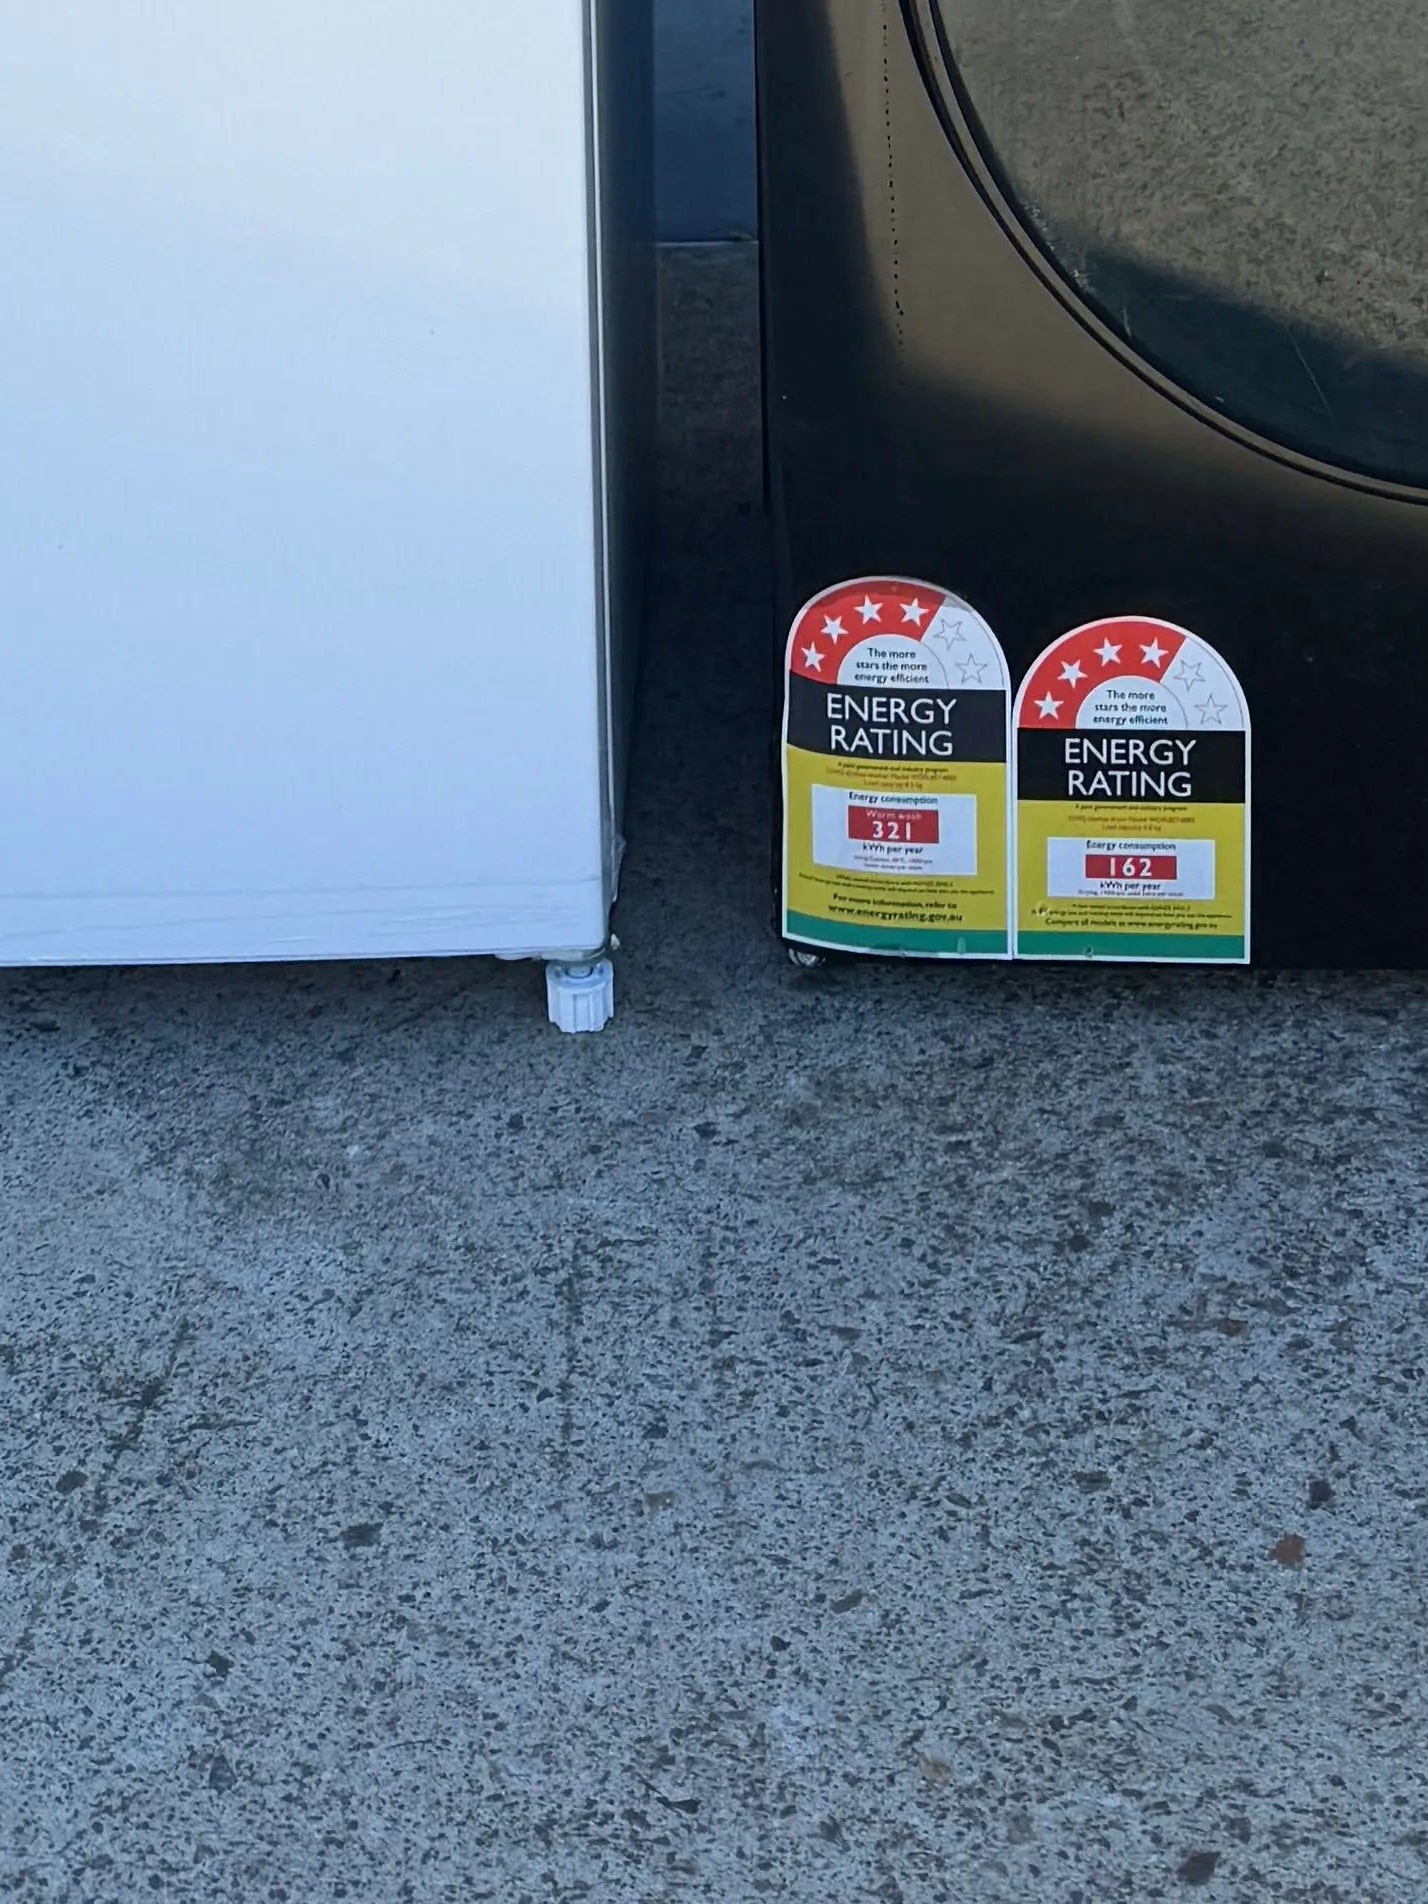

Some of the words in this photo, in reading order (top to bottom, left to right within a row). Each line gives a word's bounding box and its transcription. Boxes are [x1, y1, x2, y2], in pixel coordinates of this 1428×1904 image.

[868, 648, 886, 658] The
[889, 651, 916, 659] more
[856, 662, 880, 670] stars
[882, 661, 898, 670] the
[854, 674, 888, 684] energy
[890, 673, 930, 684] efficient
[1107, 690, 1125, 700] The
[1128, 692, 1155, 700] more
[827, 692, 957, 725] ENERGY
[1095, 703, 1118, 711] stars
[1121, 703, 1137, 712] the
[1093, 716, 1126, 726] energy
[1129, 715, 1169, 725] efficient
[831, 724, 953, 756] RATING
[1065, 738, 1197, 765] ENERGY
[1068, 770, 1192, 797] RATING
[849, 792, 878, 804] Energy
[880, 796, 938, 805] consumption
[866, 810, 896, 820] Warm
[898, 812, 922, 820] wash
[872, 821, 911, 840] 321
[1086, 840, 1116, 851] Energy
[1119, 841, 1176, 852] consumption
[1110, 858, 1152, 877] 162
[1100, 881, 1122, 889] kWh
[1124, 883, 1140, 891] per
[1142, 883, 1160, 891] year
